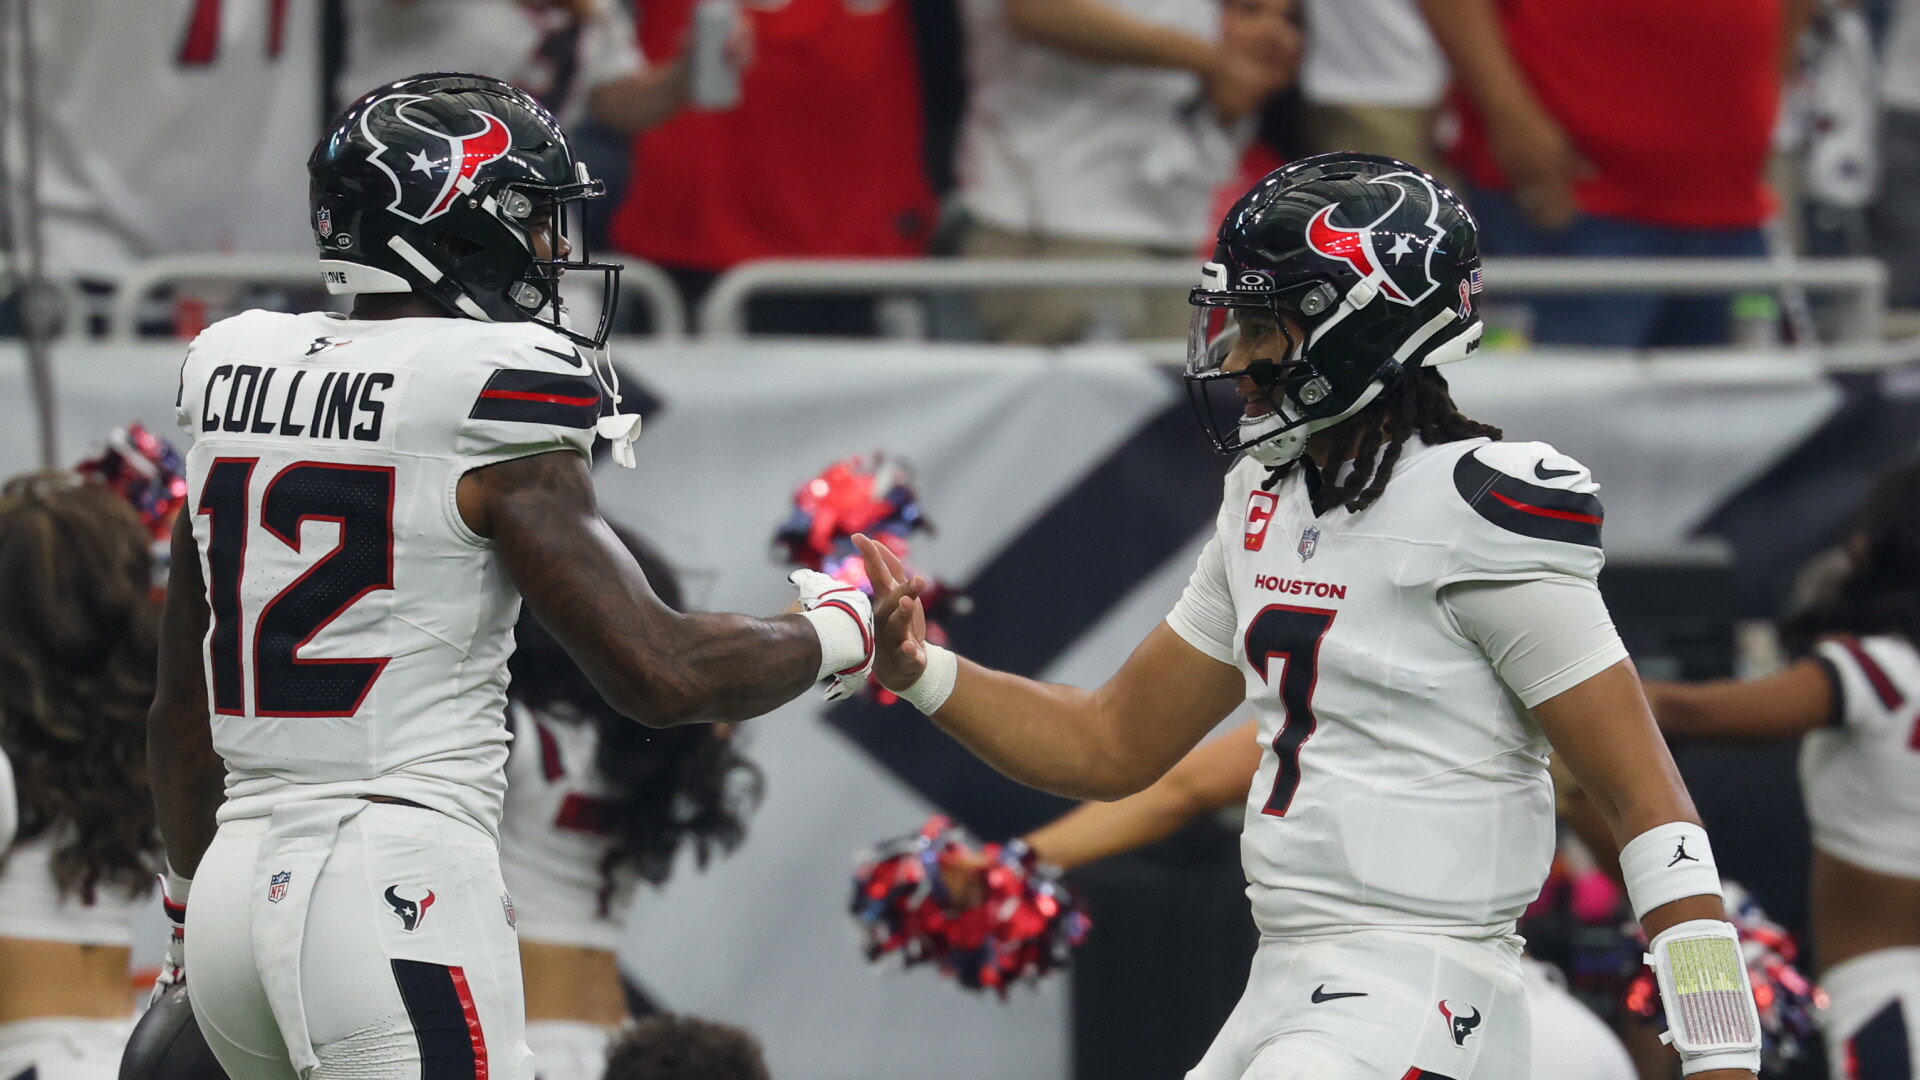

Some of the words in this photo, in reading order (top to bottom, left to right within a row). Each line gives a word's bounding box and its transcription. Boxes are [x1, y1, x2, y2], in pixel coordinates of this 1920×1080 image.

[202, 364, 394, 442] COLLINS
[1245, 494, 1274, 535] C
[1299, 540, 1318, 556] NFL
[196, 457, 396, 718] 12
[1254, 573, 1347, 600] HOUSTON
[1244, 603, 1338, 817] 7
[269, 882, 289, 899] NFL
